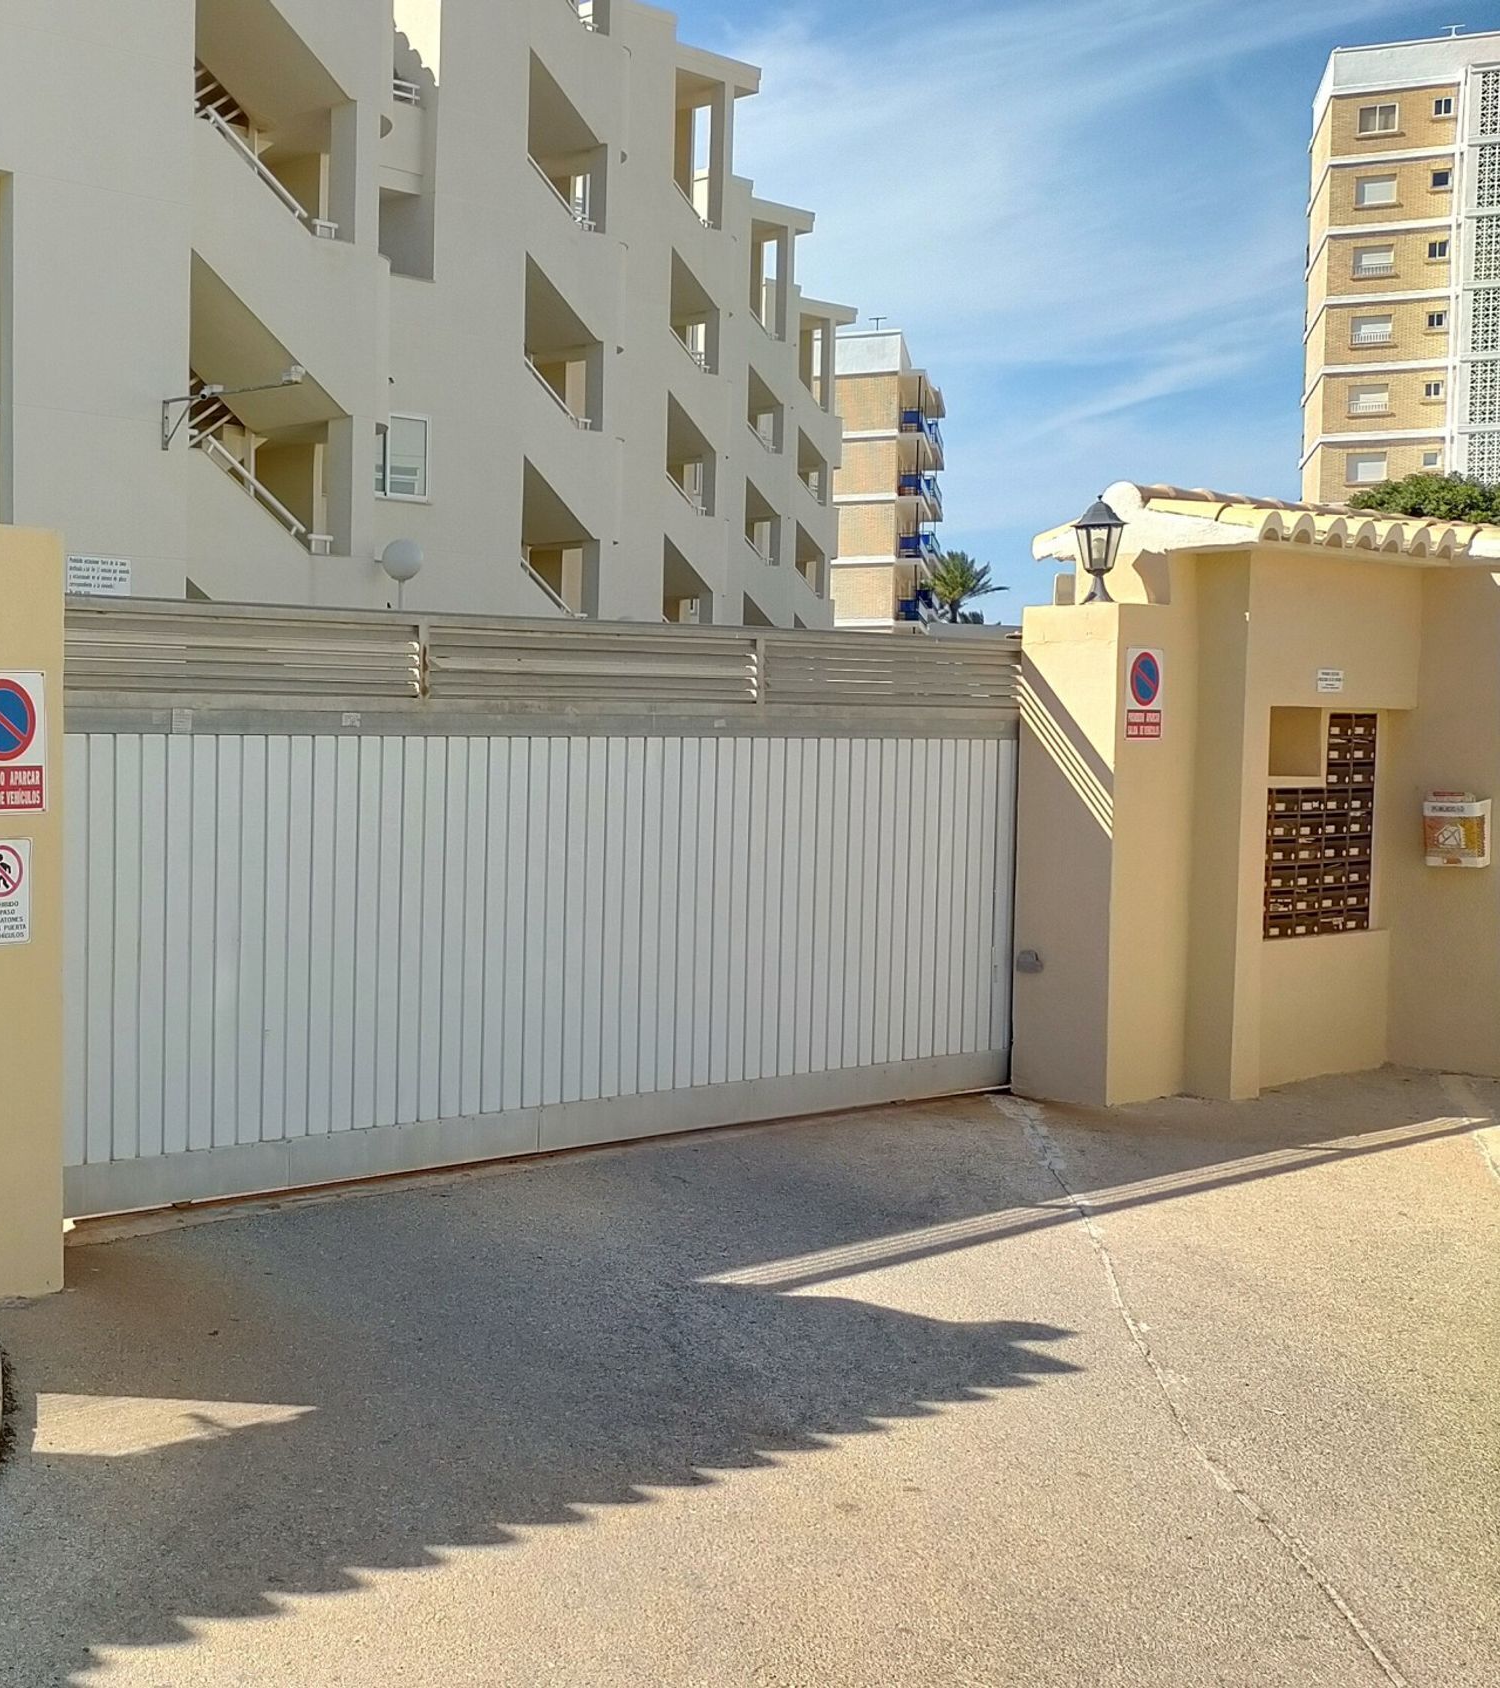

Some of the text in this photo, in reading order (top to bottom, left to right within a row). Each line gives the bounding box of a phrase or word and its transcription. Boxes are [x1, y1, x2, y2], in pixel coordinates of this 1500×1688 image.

[9, 770, 40, 786] APARCAR
[6, 787, 40, 805] VEHÍCULOS
[3, 923, 26, 931] PUERTA
